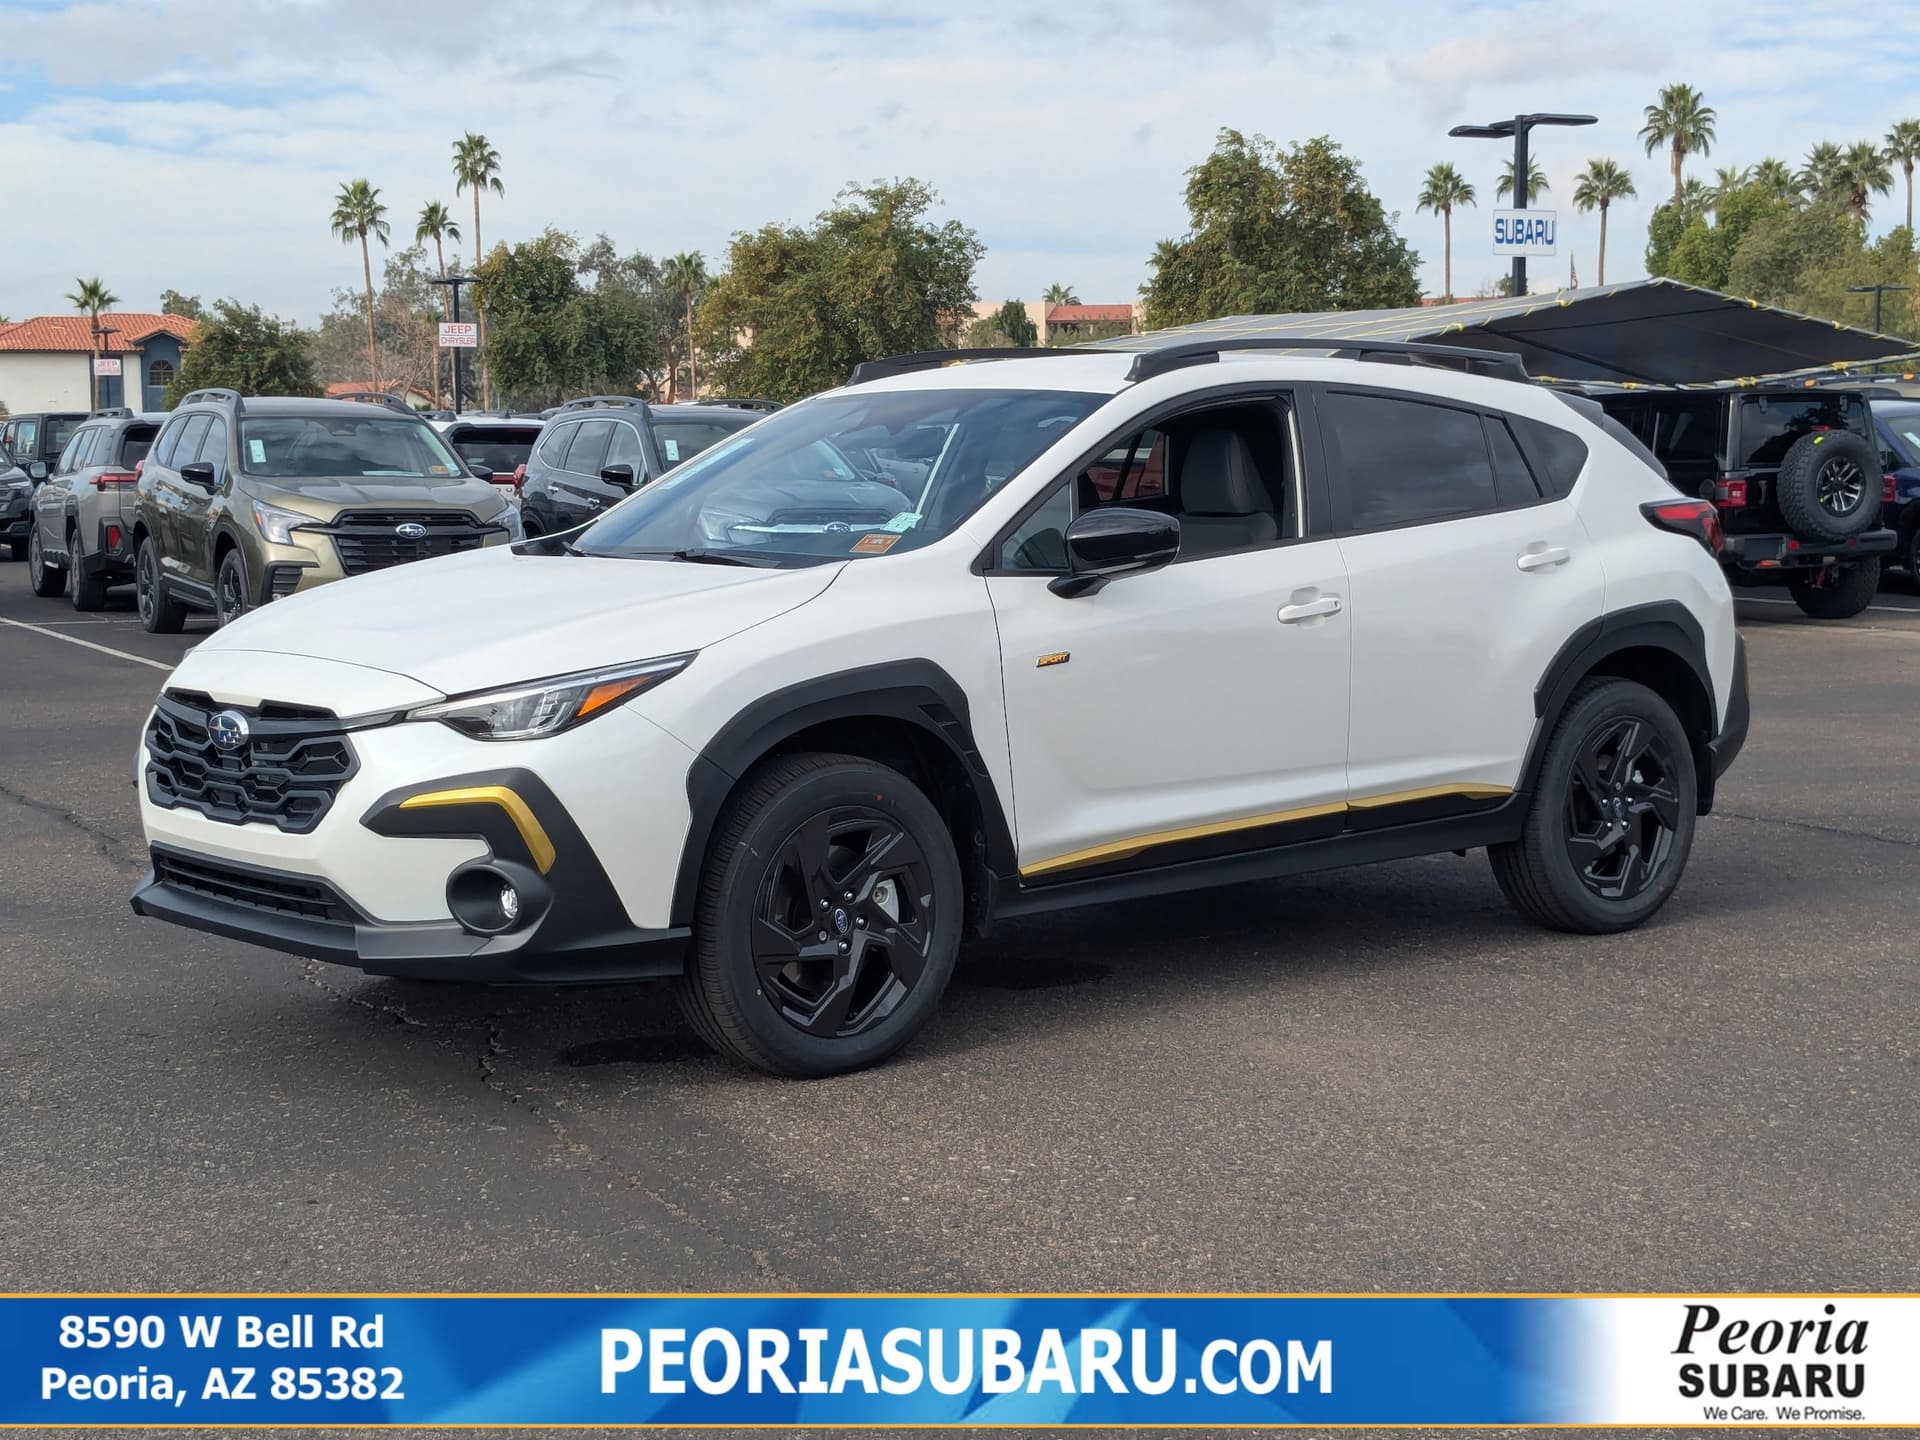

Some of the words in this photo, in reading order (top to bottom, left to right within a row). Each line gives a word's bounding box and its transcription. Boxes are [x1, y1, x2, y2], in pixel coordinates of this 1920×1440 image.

[1495, 218, 1554, 245] SUBARU
[444, 325, 472, 334] JEEP
[1038, 652, 1069, 666] SPORT
